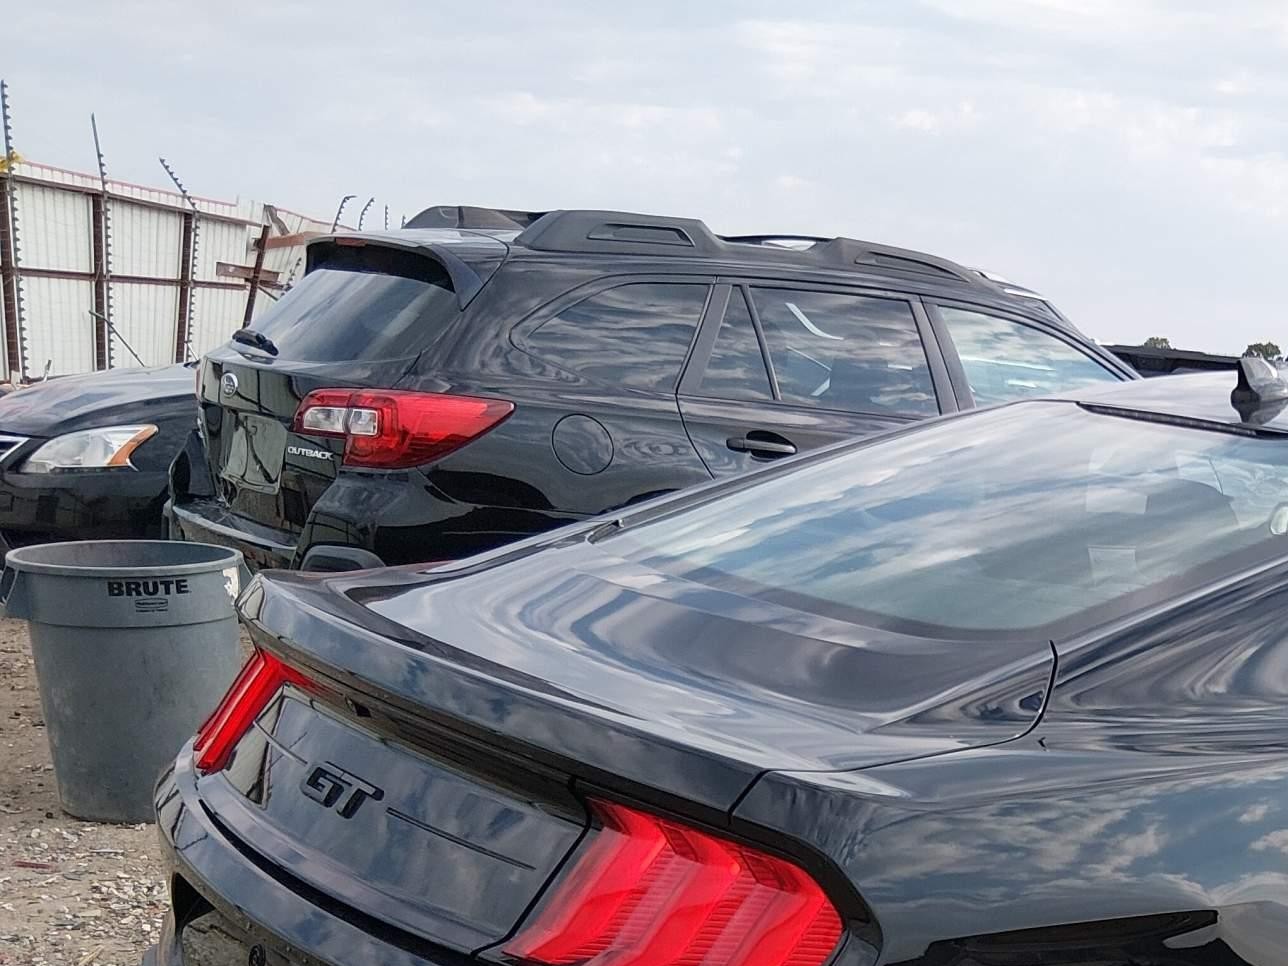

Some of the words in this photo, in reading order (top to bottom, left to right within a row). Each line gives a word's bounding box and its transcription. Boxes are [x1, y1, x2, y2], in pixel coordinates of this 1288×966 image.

[287, 446, 334, 461] OUTBACK
[107, 579, 189, 597] BRUTE
[300, 760, 385, 819] GT
